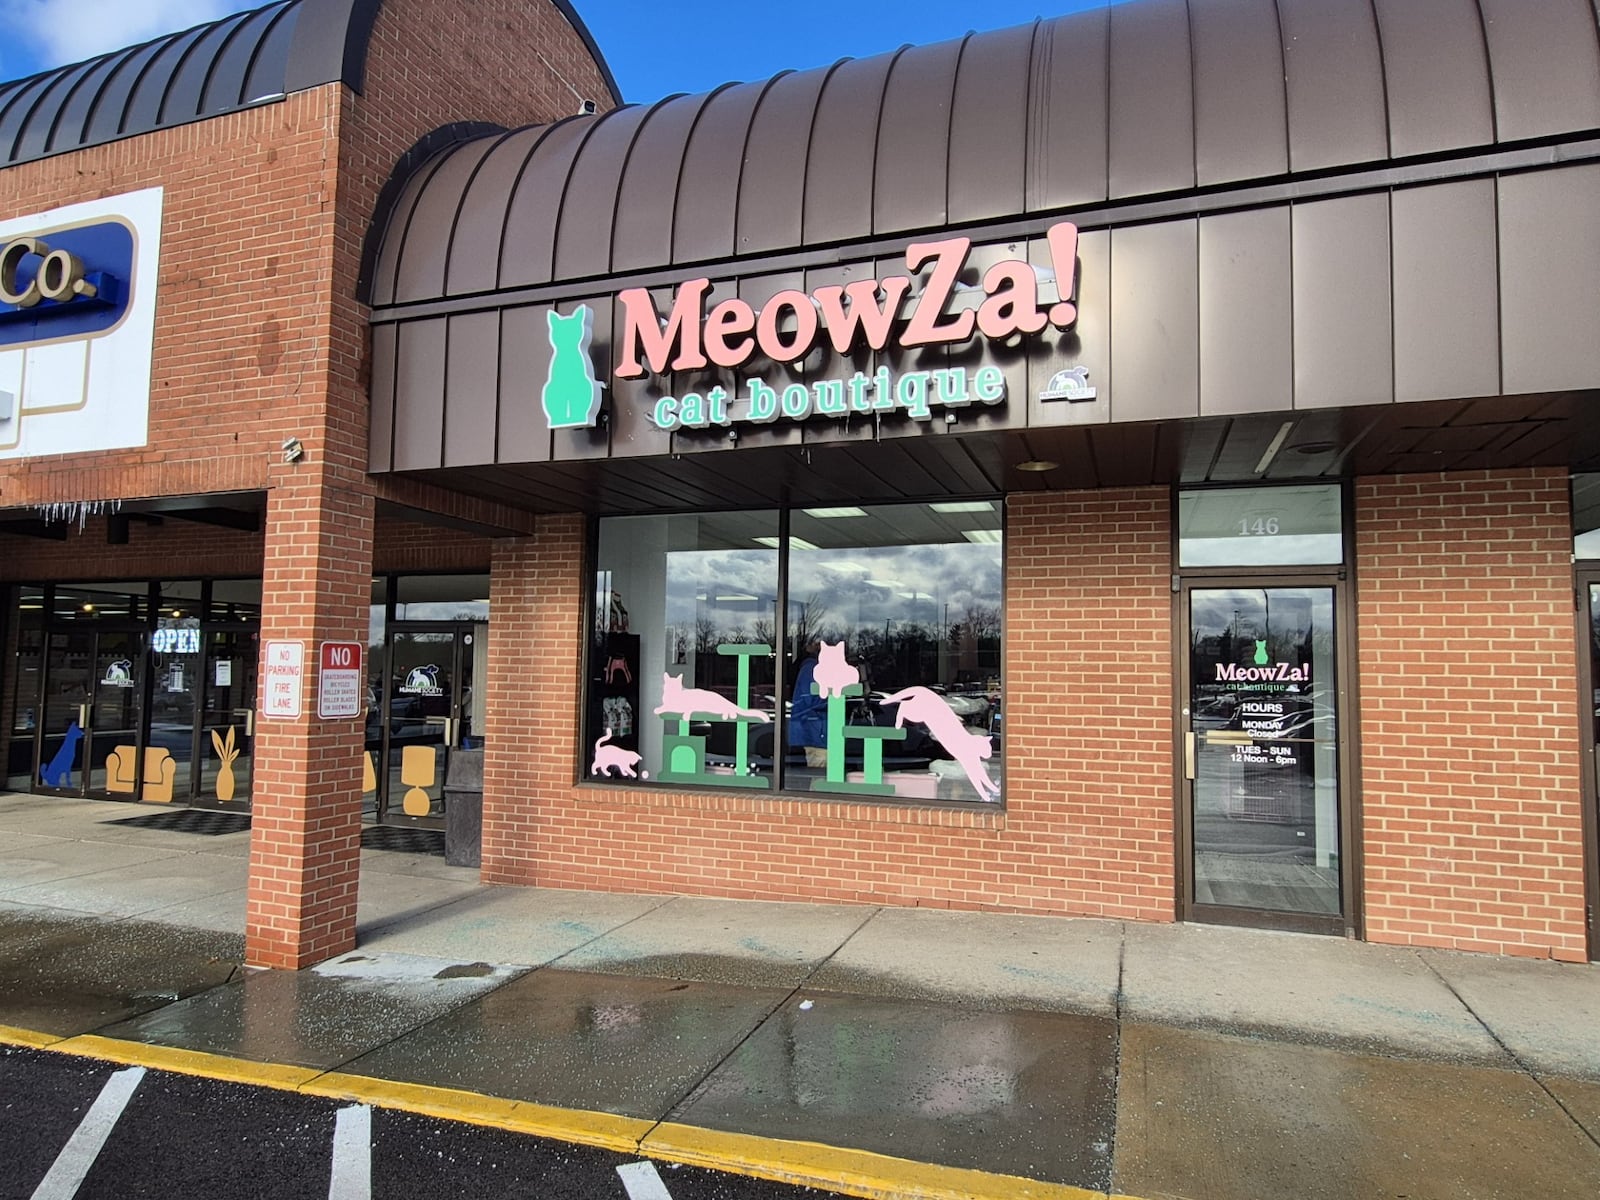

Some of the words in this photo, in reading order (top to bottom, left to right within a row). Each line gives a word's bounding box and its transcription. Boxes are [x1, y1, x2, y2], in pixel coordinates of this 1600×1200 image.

[0, 237, 96, 307] Co.
[614, 221, 1079, 379] MeowZa!
[653, 394, 727, 430] cat
[746, 365, 1004, 421] boutique
[1238, 517, 1280, 536] 146
[153, 629, 200, 653] OPEN
[280, 650, 290, 661] NO
[331, 647, 351, 666] NO
[268, 665, 299, 676] PARKING
[1215, 662, 1309, 681] MeowZa!
[275, 682, 291, 693] FIRE
[273, 698, 291, 709] LANE
[1242, 703, 1283, 713] HOURS
[1242, 721, 1283, 730] MONDAY
[1247, 729, 1279, 738] Closed
[1235, 746, 1261, 754] TUES
[1270, 747, 1291, 755] SUN
[1231, 754, 1242, 762] 12
[1243, 755, 1268, 763] Noon
[1275, 756, 1296, 765] 6pm
